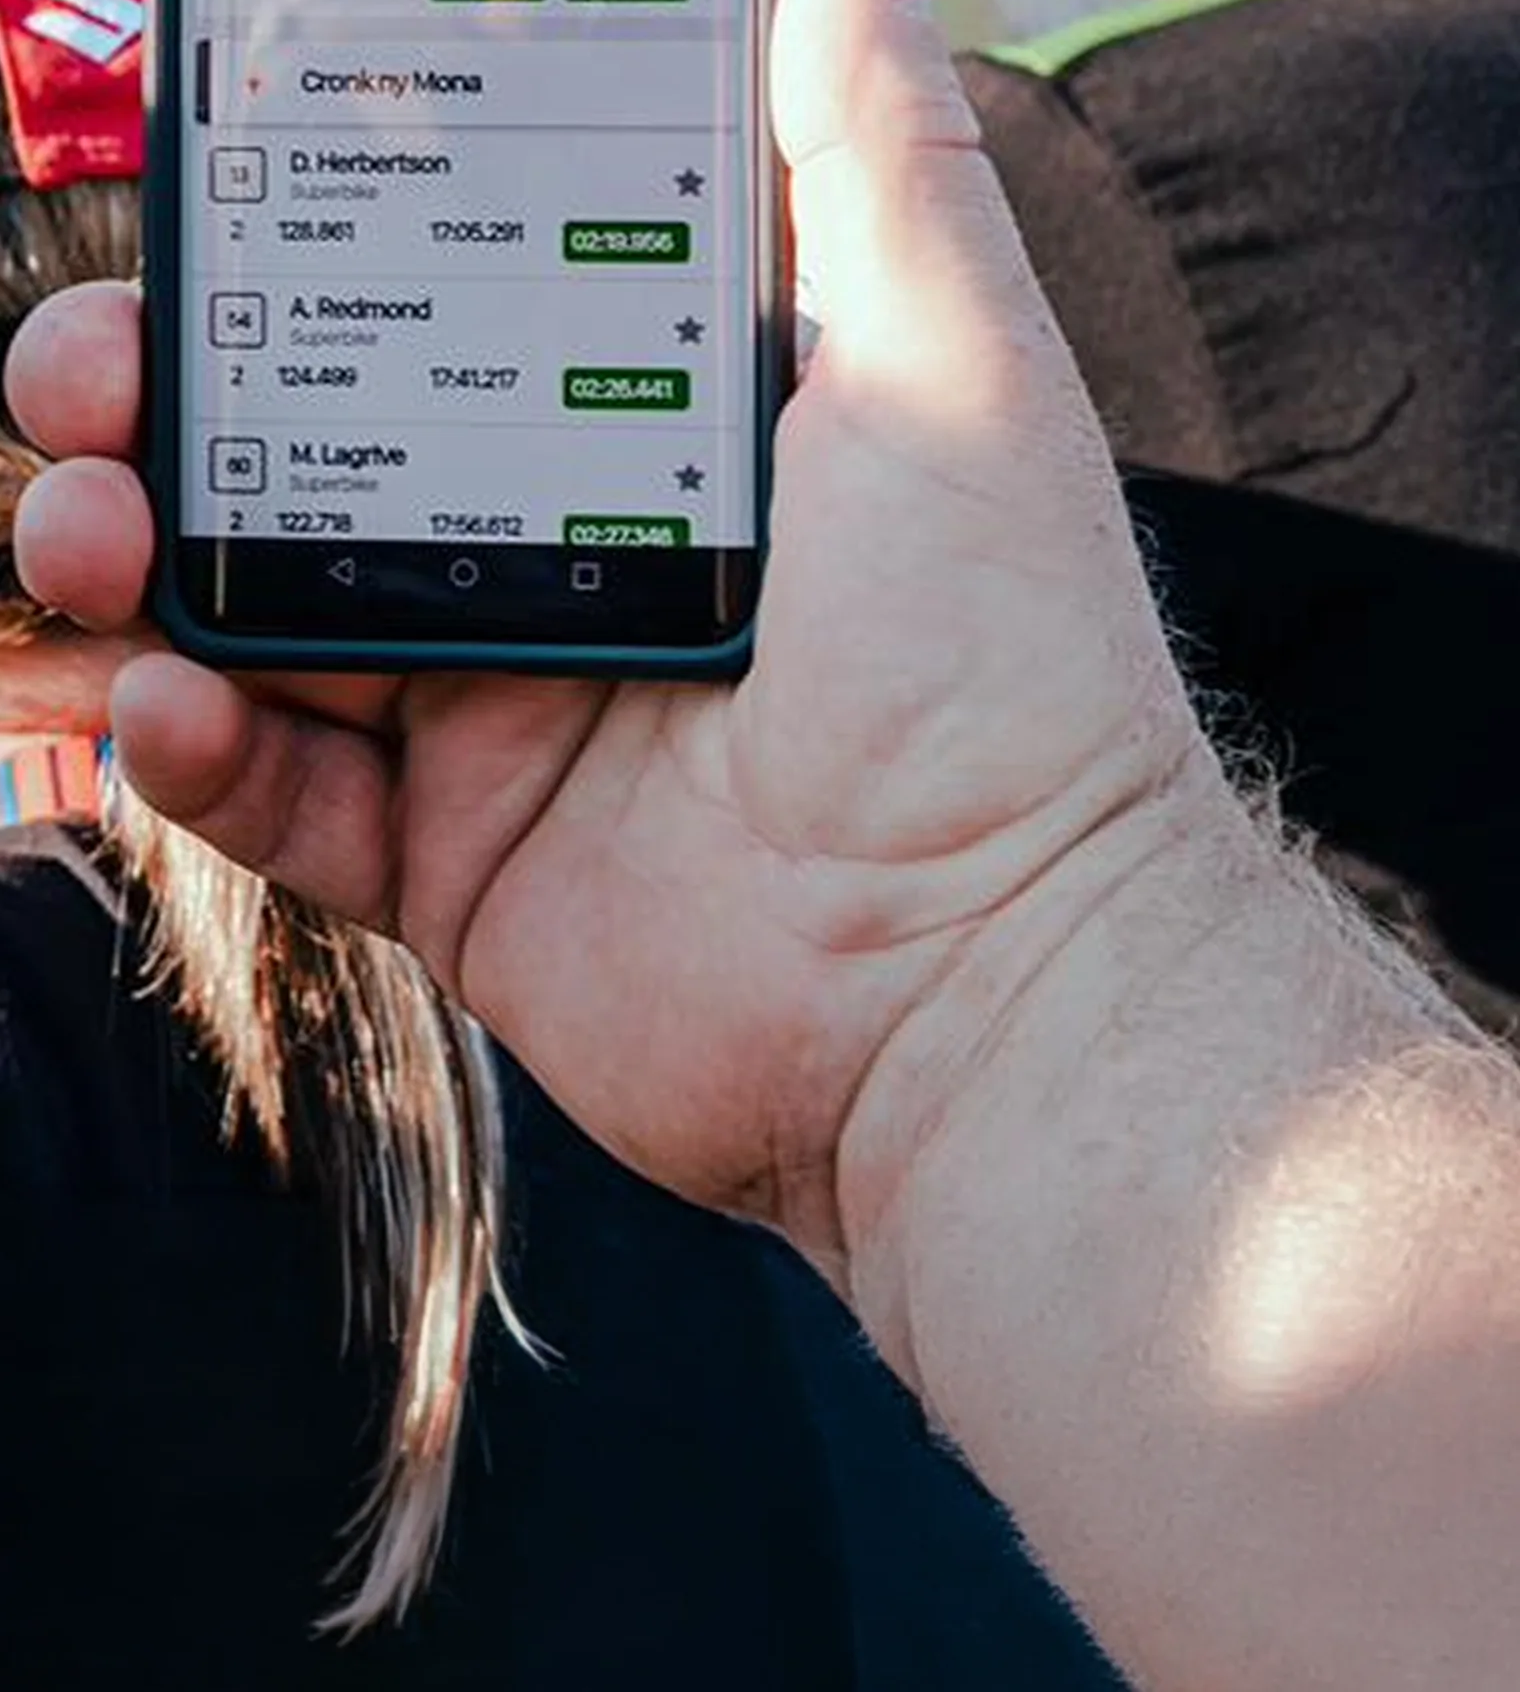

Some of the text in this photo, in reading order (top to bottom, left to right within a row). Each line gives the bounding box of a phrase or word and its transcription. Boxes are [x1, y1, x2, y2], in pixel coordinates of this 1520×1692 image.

[301, 68, 377, 94] Cronk
[412, 70, 483, 94] Mona
[317, 150, 453, 175] Herbertson
[316, 295, 433, 321] Redmond
